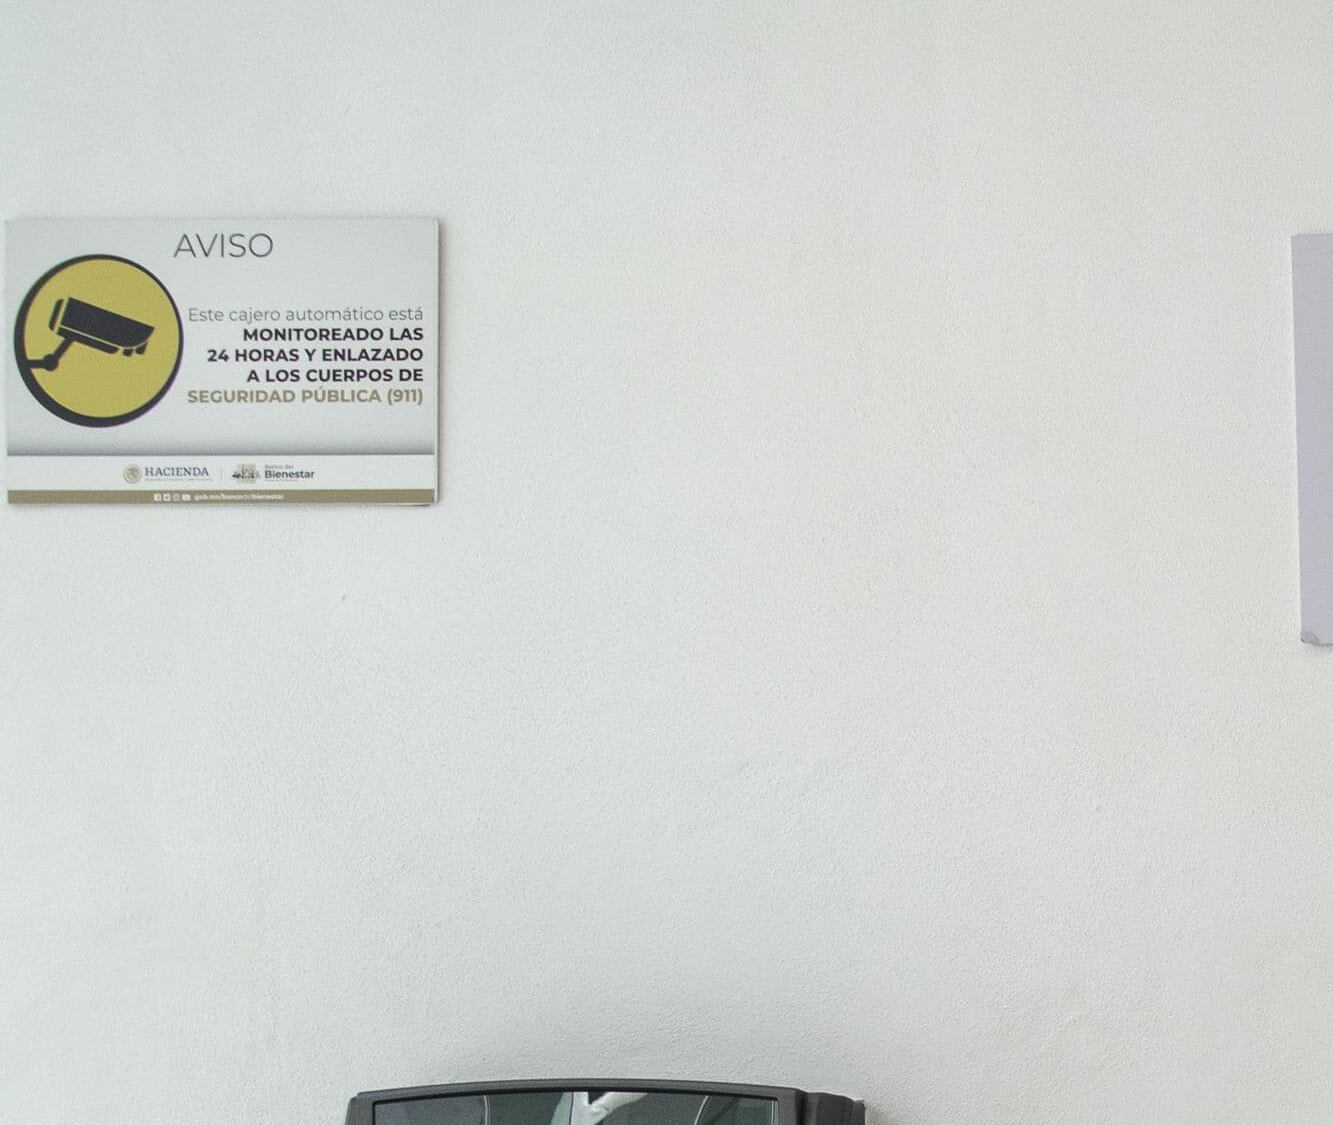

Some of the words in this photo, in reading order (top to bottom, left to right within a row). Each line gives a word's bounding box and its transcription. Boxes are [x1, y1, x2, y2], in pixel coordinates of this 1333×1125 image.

[173, 233, 273, 258] AVISO
[189, 308, 224, 322] Este
[229, 308, 281, 325] cajero
[286, 307, 384, 321] automático
[389, 307, 424, 321] está
[243, 328, 384, 341] MONITOREADO
[390, 328, 424, 341] LAS
[207, 349, 229, 362] 24
[235, 349, 300, 362] HORAS
[305, 349, 316, 361] Y
[322, 348, 424, 362] ENLAZADO
[247, 369, 260, 382] A
[266, 369, 300, 382] LOS
[306, 369, 394, 382] CUERPOS
[400, 369, 424, 382] DE
[188, 390, 296, 403] SEGURIDAD
[302, 386, 382, 402] PÚBLICA
[387, 388, 424, 405] (911)
[145, 467, 210, 477] HACIENDA
[264, 469, 315, 479] Bienestar
